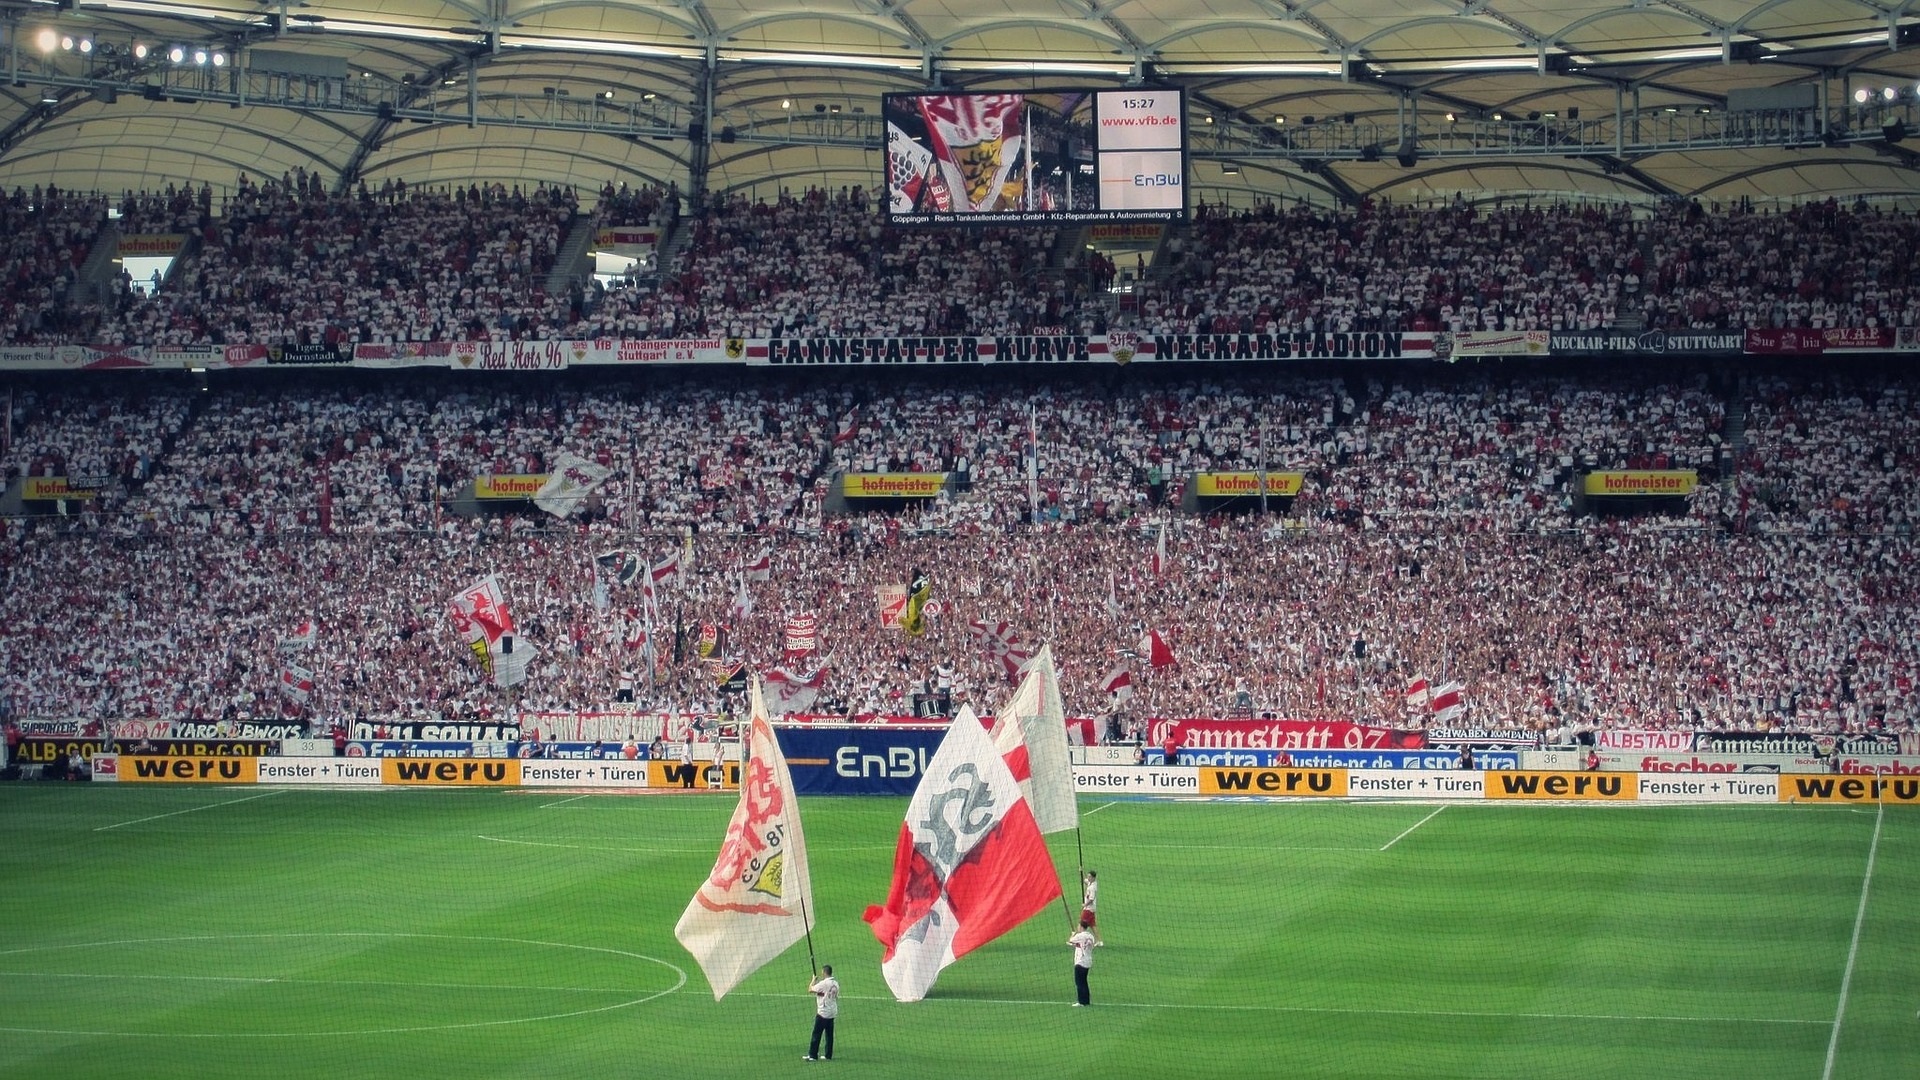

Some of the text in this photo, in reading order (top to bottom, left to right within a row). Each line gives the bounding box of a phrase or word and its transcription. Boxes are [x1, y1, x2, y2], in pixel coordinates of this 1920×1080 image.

[1122, 98, 1155, 109] 15:27
[1101, 115, 1177, 127] www.vfb.de
[1134, 174, 1180, 186] EnBW
[935, 214, 954, 222] Riess
[956, 214, 1021, 222] Tankstellenbetriebe
[1022, 213, 1045, 221] GmbH
[1051, 212, 1108, 221] Kfz-Reparaturen
[1109, 211, 1115, 219] &
[1116, 211, 1171, 220] Autovermietung
[295, 343, 325, 353] Tigers
[594, 338, 721, 352] VfB Anhängerverband
[769, 336, 1089, 363] CANNSTATTER KURVE
[1155, 333, 1402, 360] NECKARSTADION
[1552, 335, 1743, 350] NECKAR-FILS STUTTGART
[229, 349, 248, 360] 0711
[285, 351, 335, 361] Dornstadt
[480, 341, 507, 369] Red
[511, 341, 541, 369] Hots
[545, 341, 561, 368] 96
[617, 350, 667, 361] Stuttgart
[493, 478, 548, 492] hofmei
[862, 477, 934, 491] hofmeister
[1216, 476, 1289, 489] hofmester
[1605, 475, 1682, 488] hofmeister
[243, 725, 303, 739] BWOYS
[421, 725, 520, 742] SQUAD
[1152, 720, 1386, 750] Cannstatt 97
[1428, 728, 1488, 738] SCHWABEN
[302, 742, 314, 751] 33
[1599, 731, 1693, 749] ALBSTADT
[1106, 750, 1119, 759] 35
[1176, 751, 1257, 766] pectra
[1423, 753, 1515, 769] spetra
[1544, 754, 1557, 763] 36
[135, 760, 241, 778] weru
[259, 763, 380, 777] Fenster + Türen
[1641, 756, 1737, 772] fischer
[397, 762, 506, 781] weru
[522, 766, 646, 780] Fenster + Türen
[1073, 772, 1197, 787] enster + Türen
[1215, 771, 1332, 791] weru
[1350, 775, 1482, 791] Fenster + Türen
[1501, 775, 1621, 795] weru
[1640, 780, 1776, 794] Fenster + Türen
[1795, 778, 1919, 799] weru
